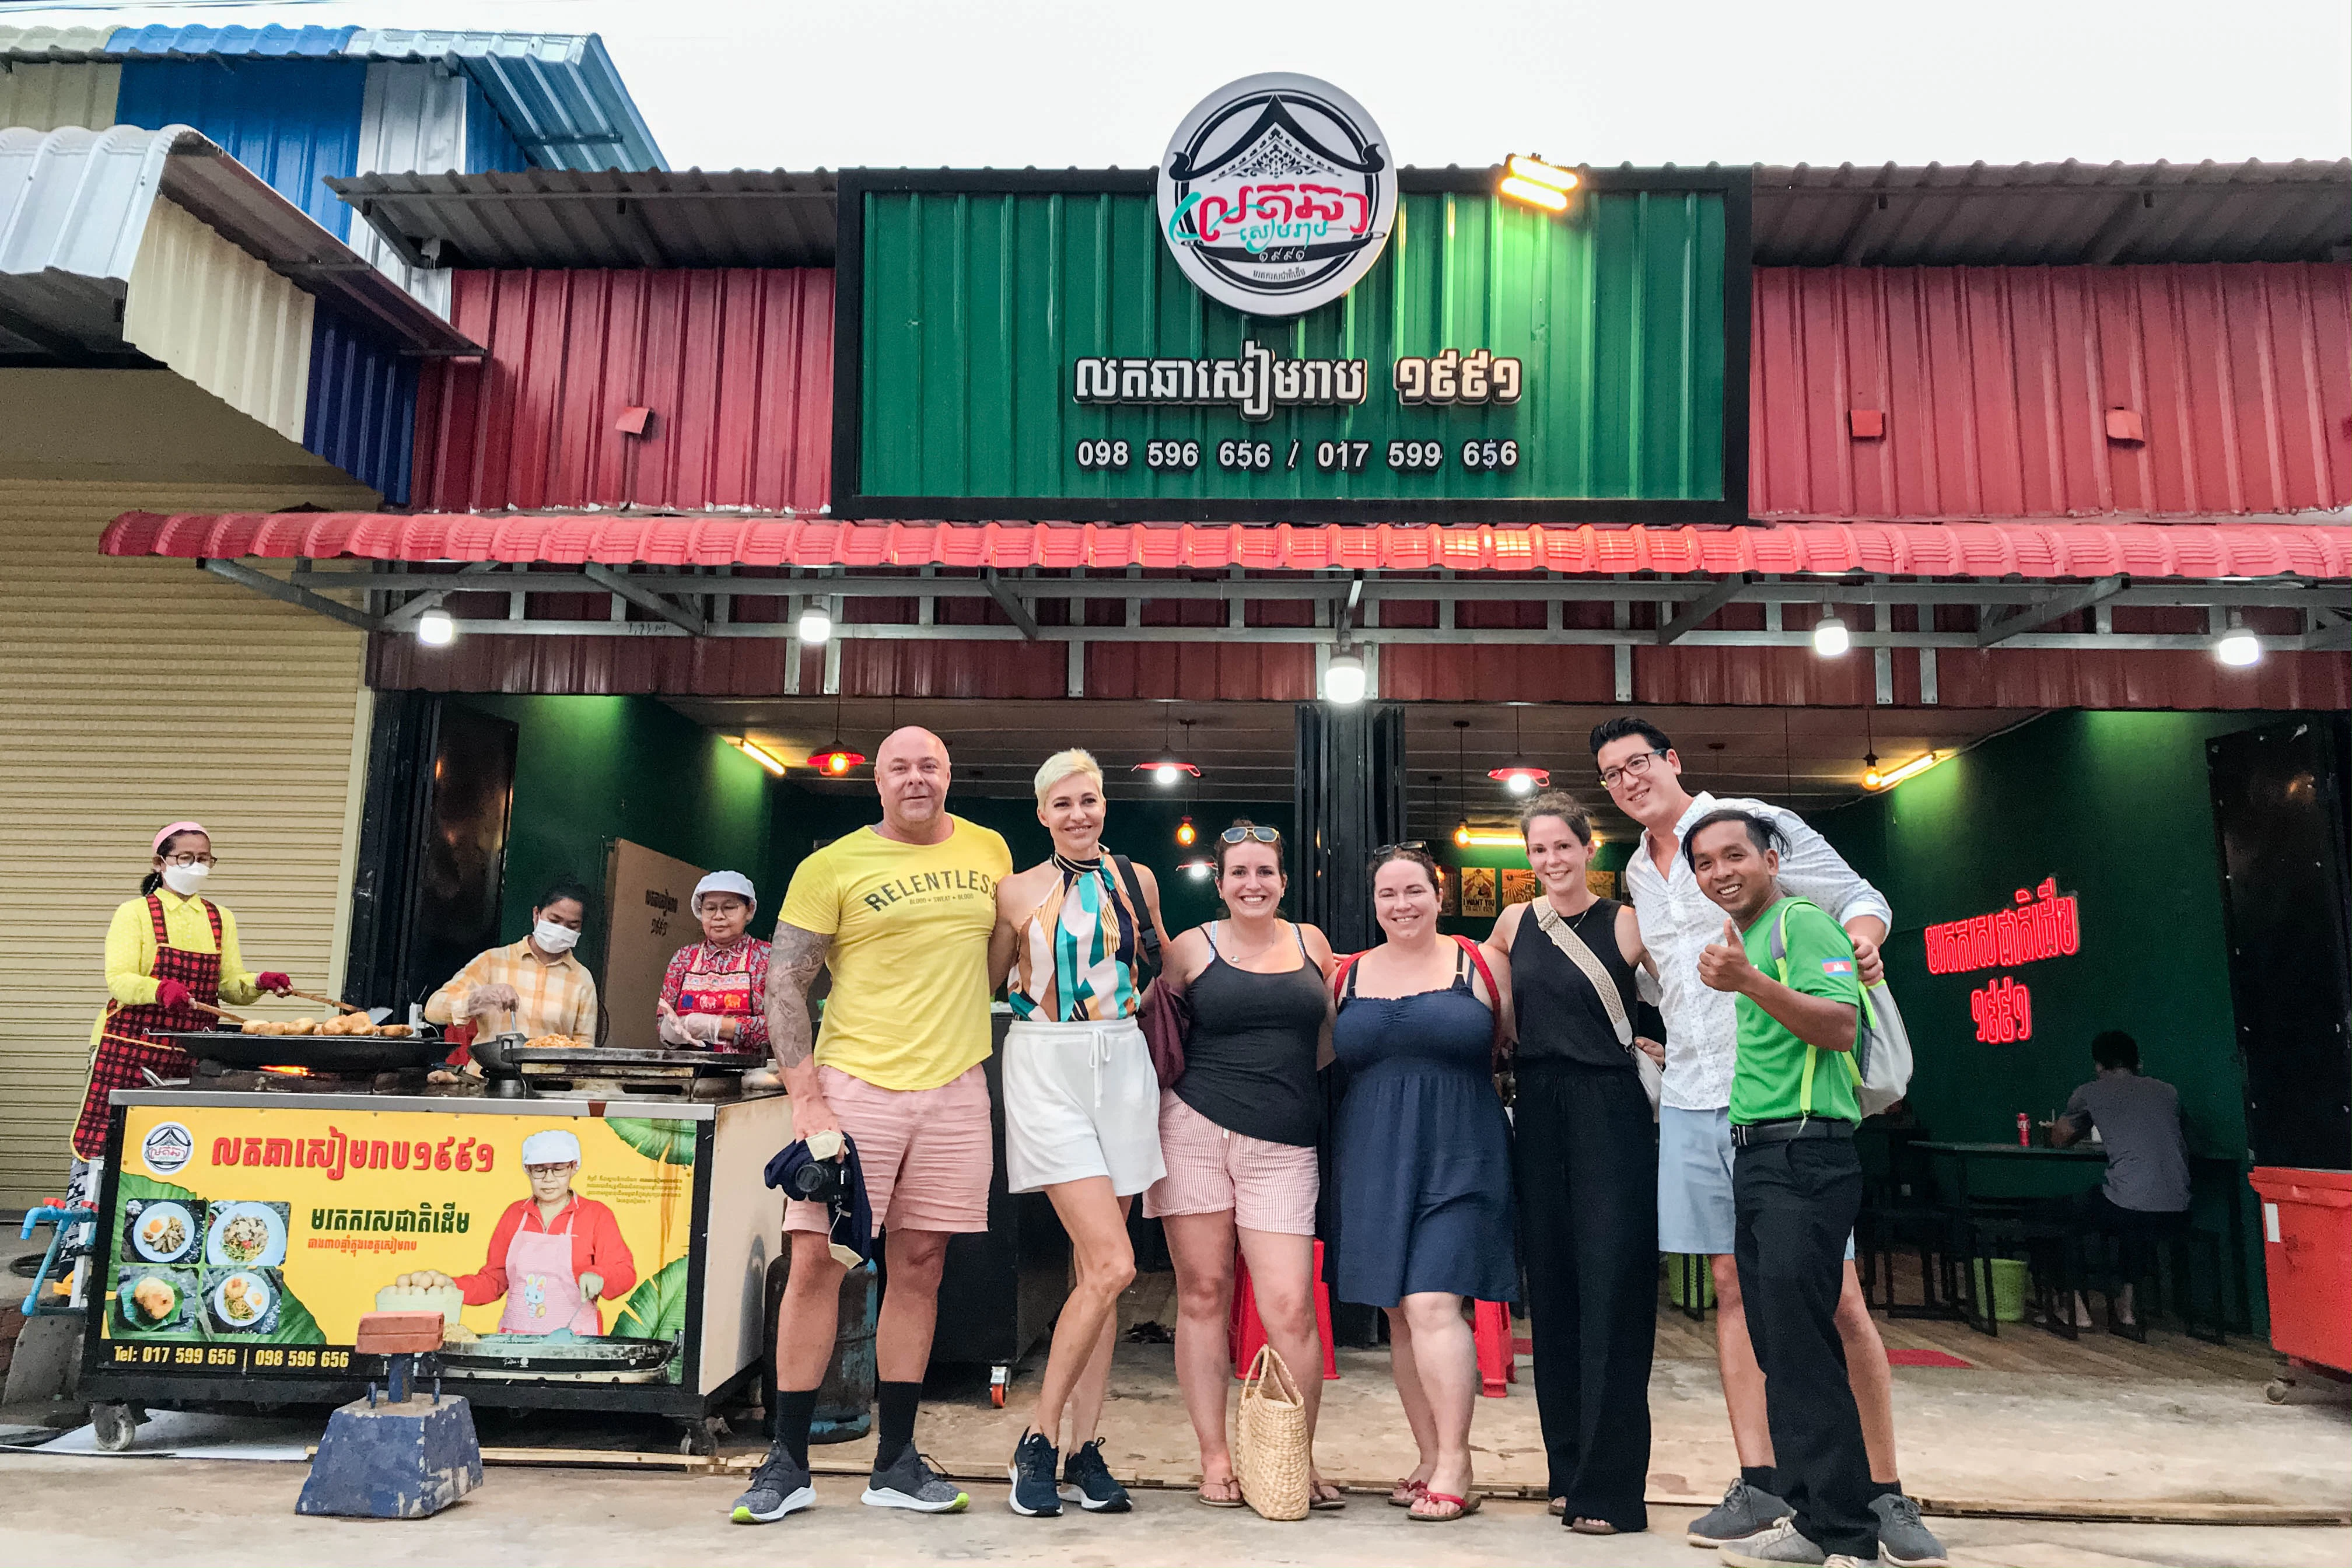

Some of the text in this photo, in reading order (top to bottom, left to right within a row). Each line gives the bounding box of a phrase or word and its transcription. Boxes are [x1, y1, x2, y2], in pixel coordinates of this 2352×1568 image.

[1077, 440, 1129, 466] 098
[1147, 442, 1199, 467] 596
[1219, 442, 1270, 468] 656
[1317, 442, 1369, 468] 017
[1388, 442, 1443, 467] 599
[1463, 440, 1517, 468] 656
[864, 870, 997, 912] RELENTLESS
[114, 1346, 138, 1363] Tel:
[142, 1346, 170, 1363] 017
[175, 1348, 204, 1364] 599
[208, 1348, 237, 1365] 656
[255, 1349, 284, 1367] 098
[288, 1350, 316, 1367] 596
[320, 1351, 349, 1368] 656
